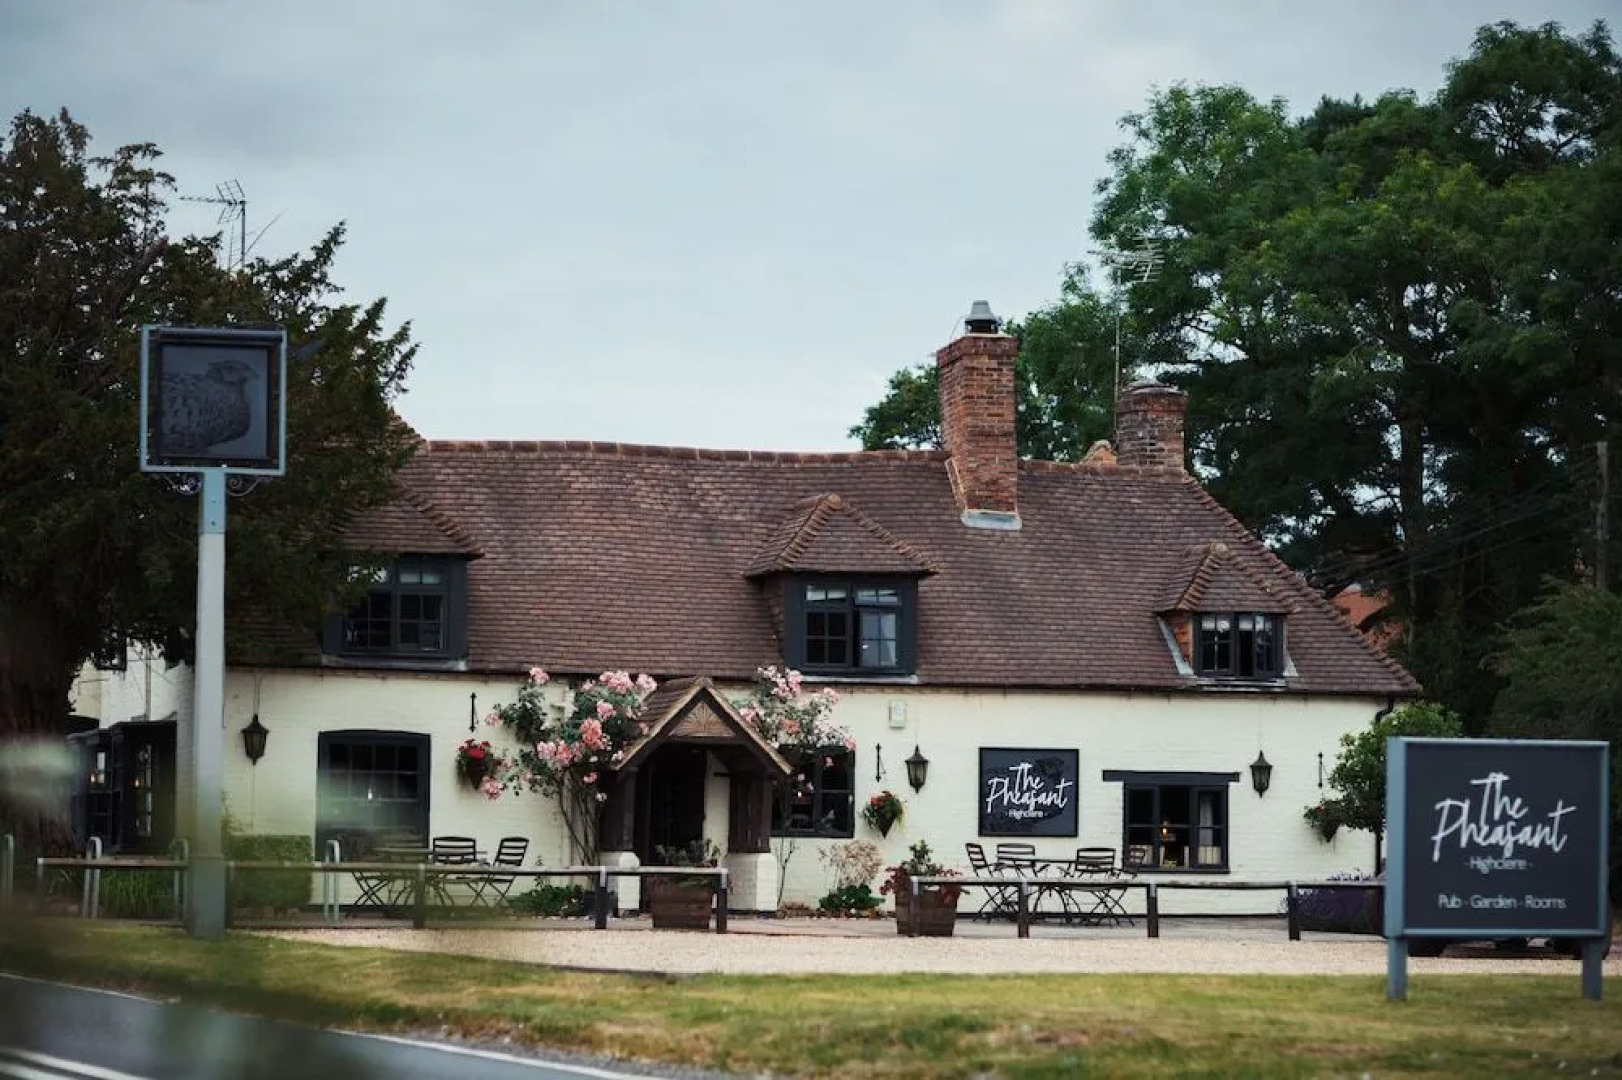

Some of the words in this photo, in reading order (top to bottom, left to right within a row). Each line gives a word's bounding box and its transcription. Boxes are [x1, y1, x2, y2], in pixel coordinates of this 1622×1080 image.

[985, 776, 1073, 814] Pheasant
[1008, 762, 1044, 793] The
[1470, 772, 1529, 826] The
[1431, 798, 1577, 863] Pheasant
[1438, 894, 1461, 908] Pub
[1471, 894, 1517, 909] Garden
[1525, 894, 1567, 909] Rooms
